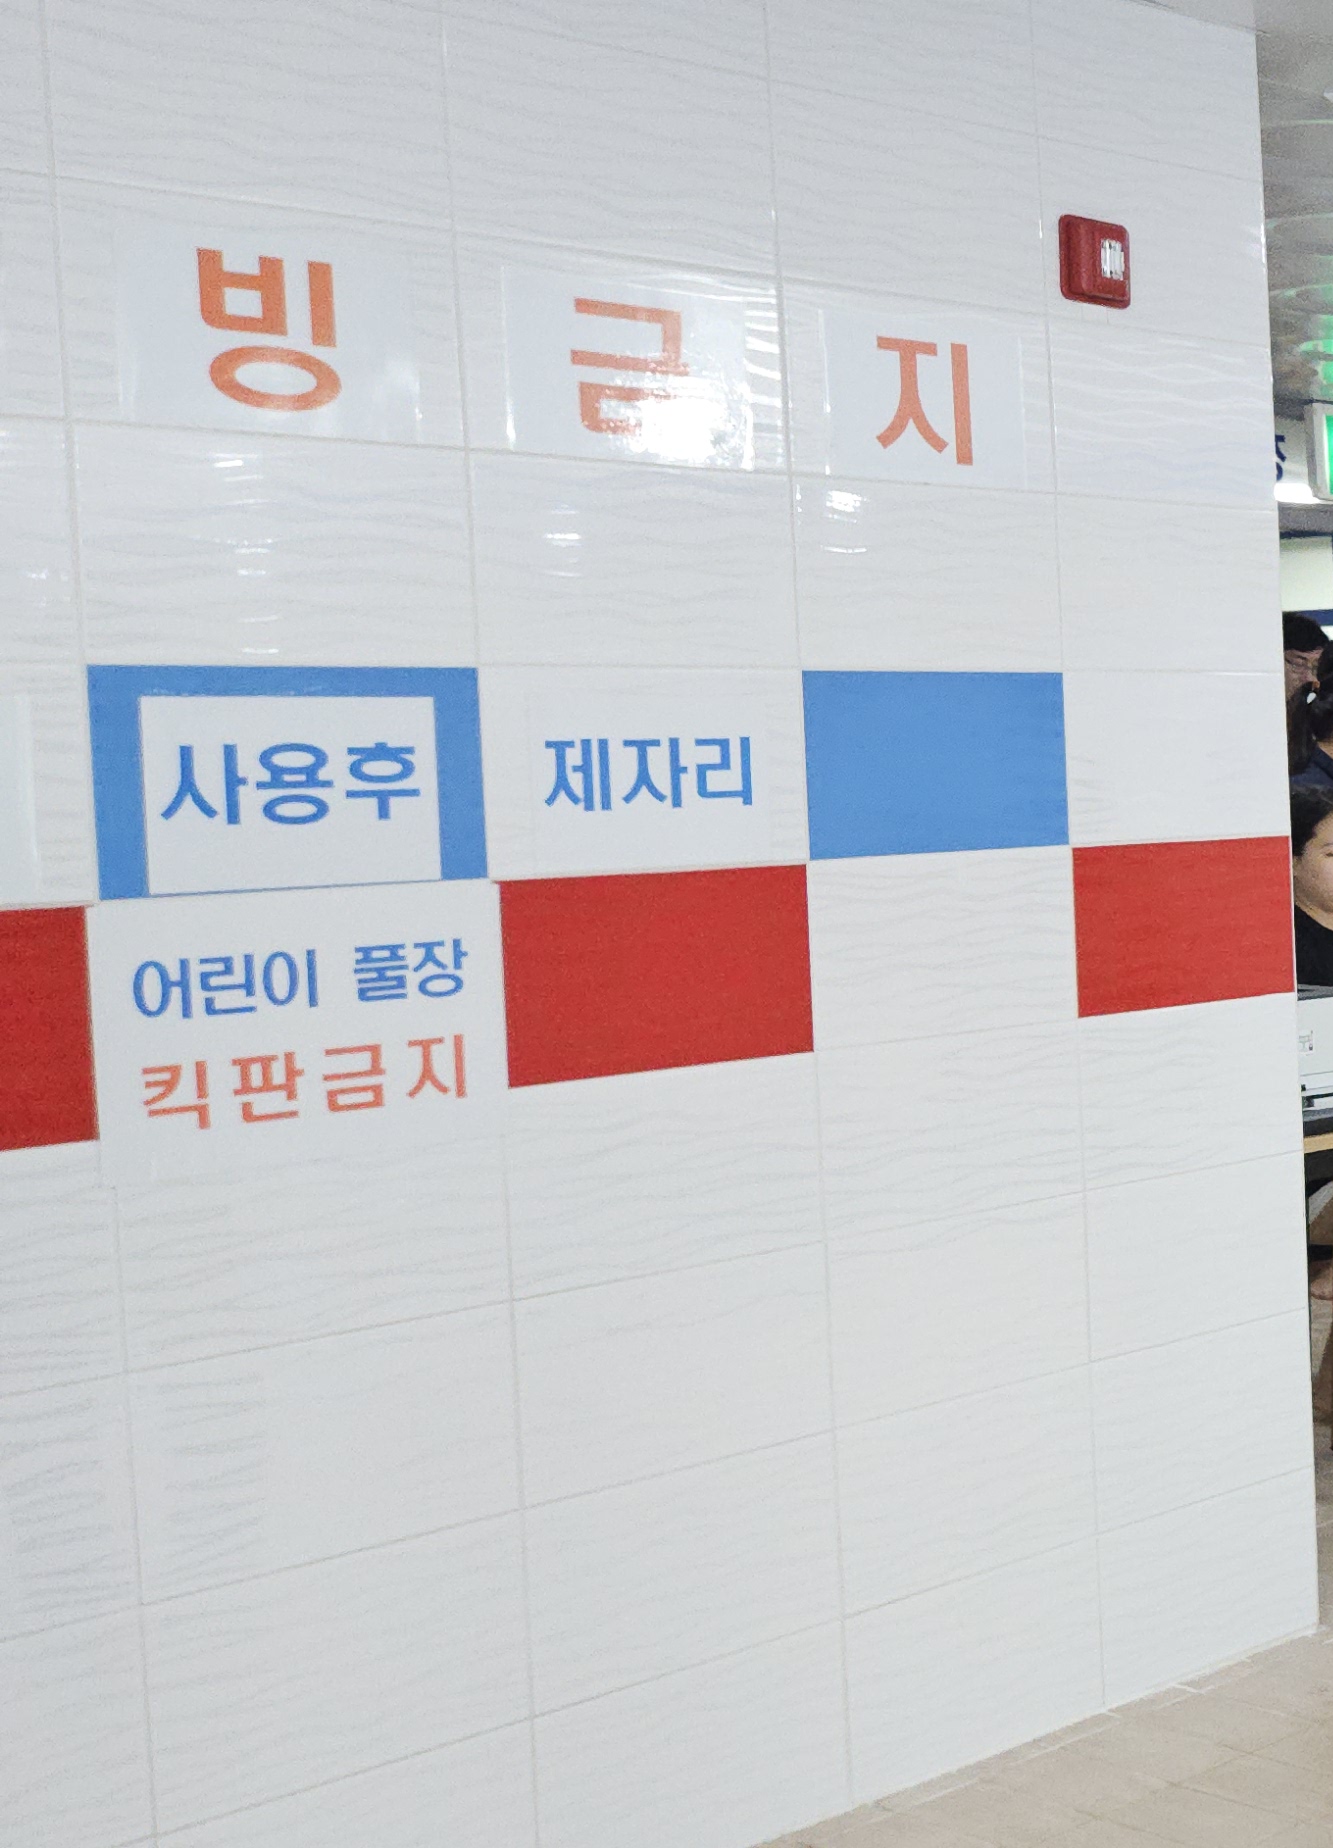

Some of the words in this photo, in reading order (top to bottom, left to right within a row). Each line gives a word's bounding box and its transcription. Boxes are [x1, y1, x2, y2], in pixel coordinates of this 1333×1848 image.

[196, 248, 342, 411] 빙
[875, 335, 974, 466] 지
[160, 741, 421, 826] 사용후
[544, 735, 755, 812] 제자리
[131, 948, 319, 1020] 어린이
[354, 938, 468, 1003] 풀장
